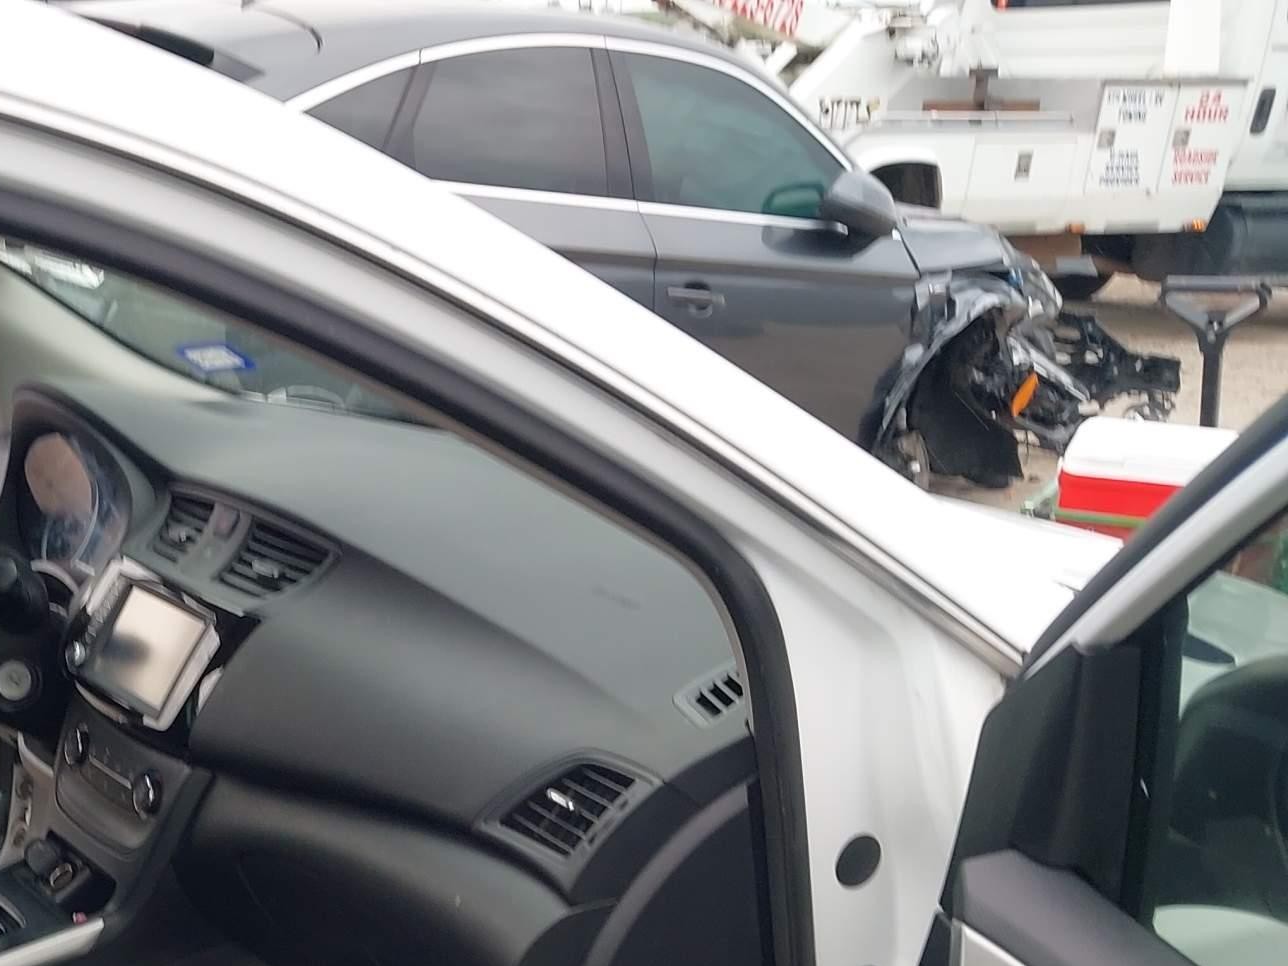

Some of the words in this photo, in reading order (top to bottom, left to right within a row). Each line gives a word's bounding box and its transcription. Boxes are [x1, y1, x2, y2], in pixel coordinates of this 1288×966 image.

[1122, 89, 1146, 104] WHEEL
[1199, 90, 1223, 106] 24
[1118, 107, 1146, 123] TOWING
[1185, 106, 1229, 122] HOUR
[1173, 150, 1217, 165] ROADSIDE
[1105, 164, 1139, 176] SERVICE
[1172, 170, 1209, 184] SERVICE
